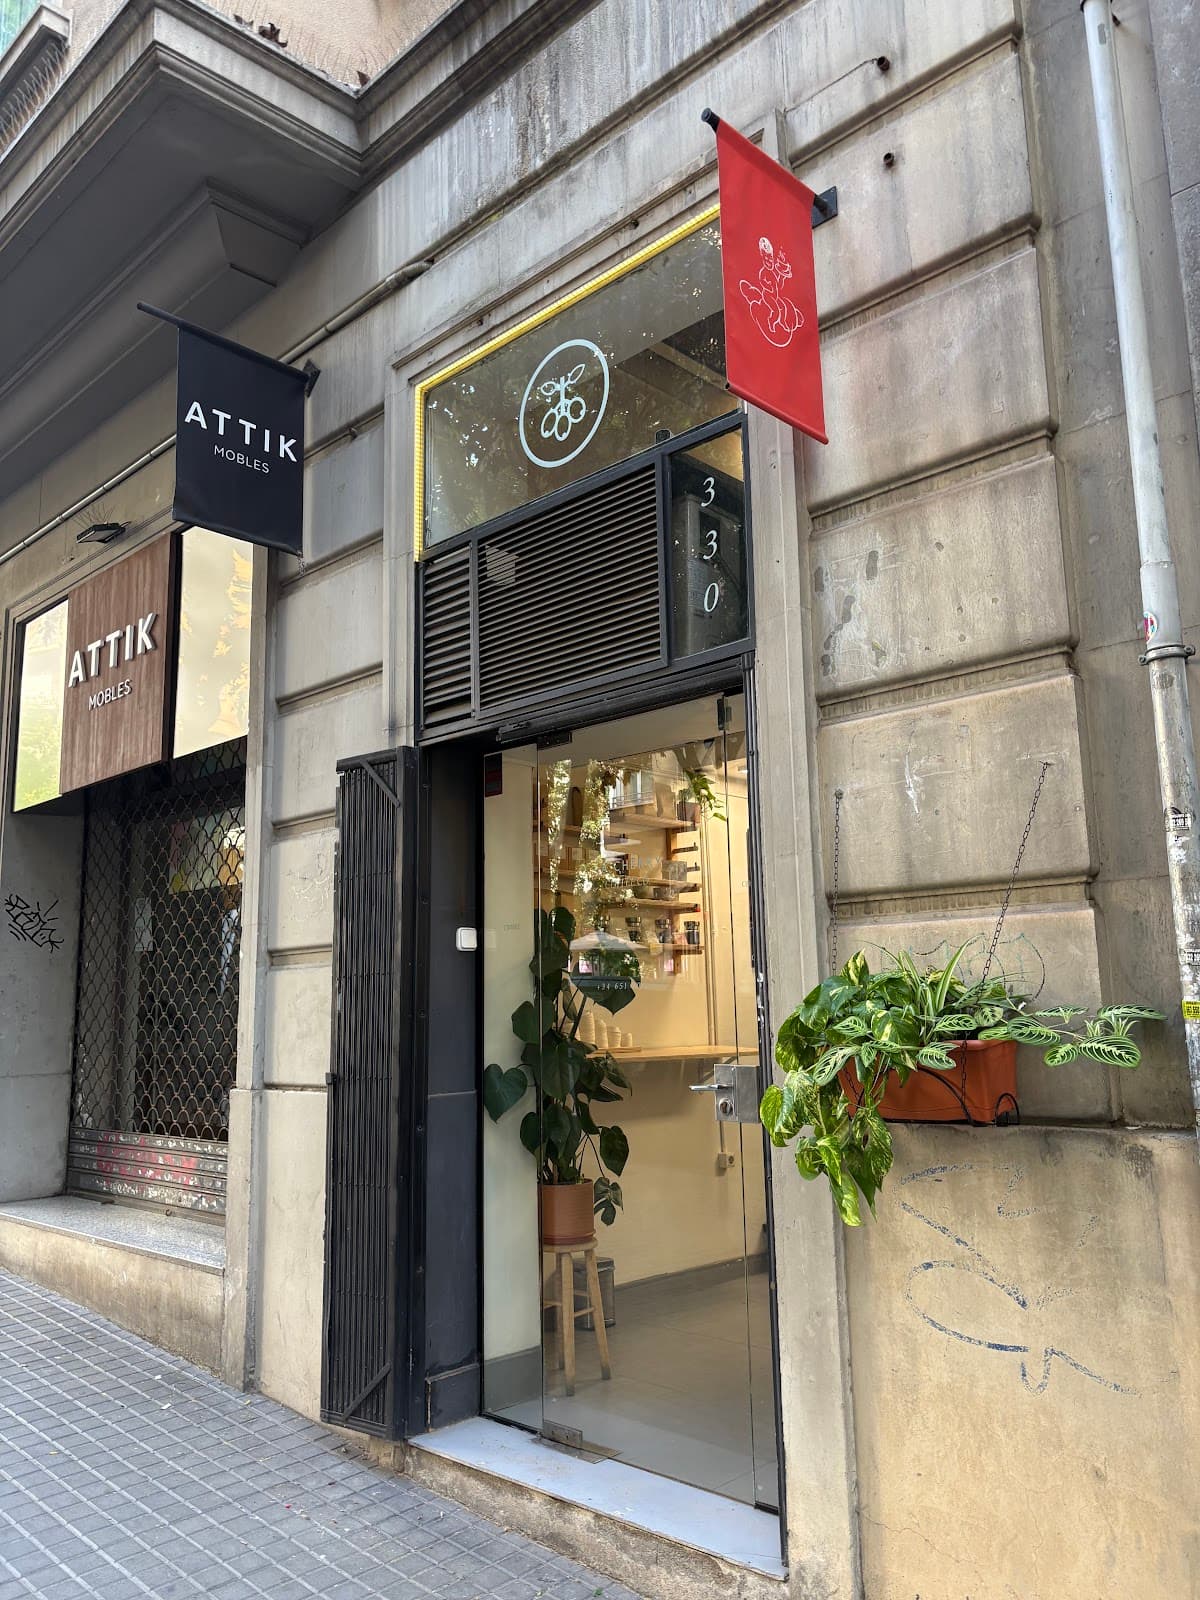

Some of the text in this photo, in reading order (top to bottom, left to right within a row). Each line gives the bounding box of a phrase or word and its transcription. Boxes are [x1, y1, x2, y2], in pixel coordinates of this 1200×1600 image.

[184, 401, 298, 463] ATTIK
[213, 444, 271, 474] MOBLES
[68, 611, 159, 688] ATTIK
[88, 678, 133, 712] MOBLES
